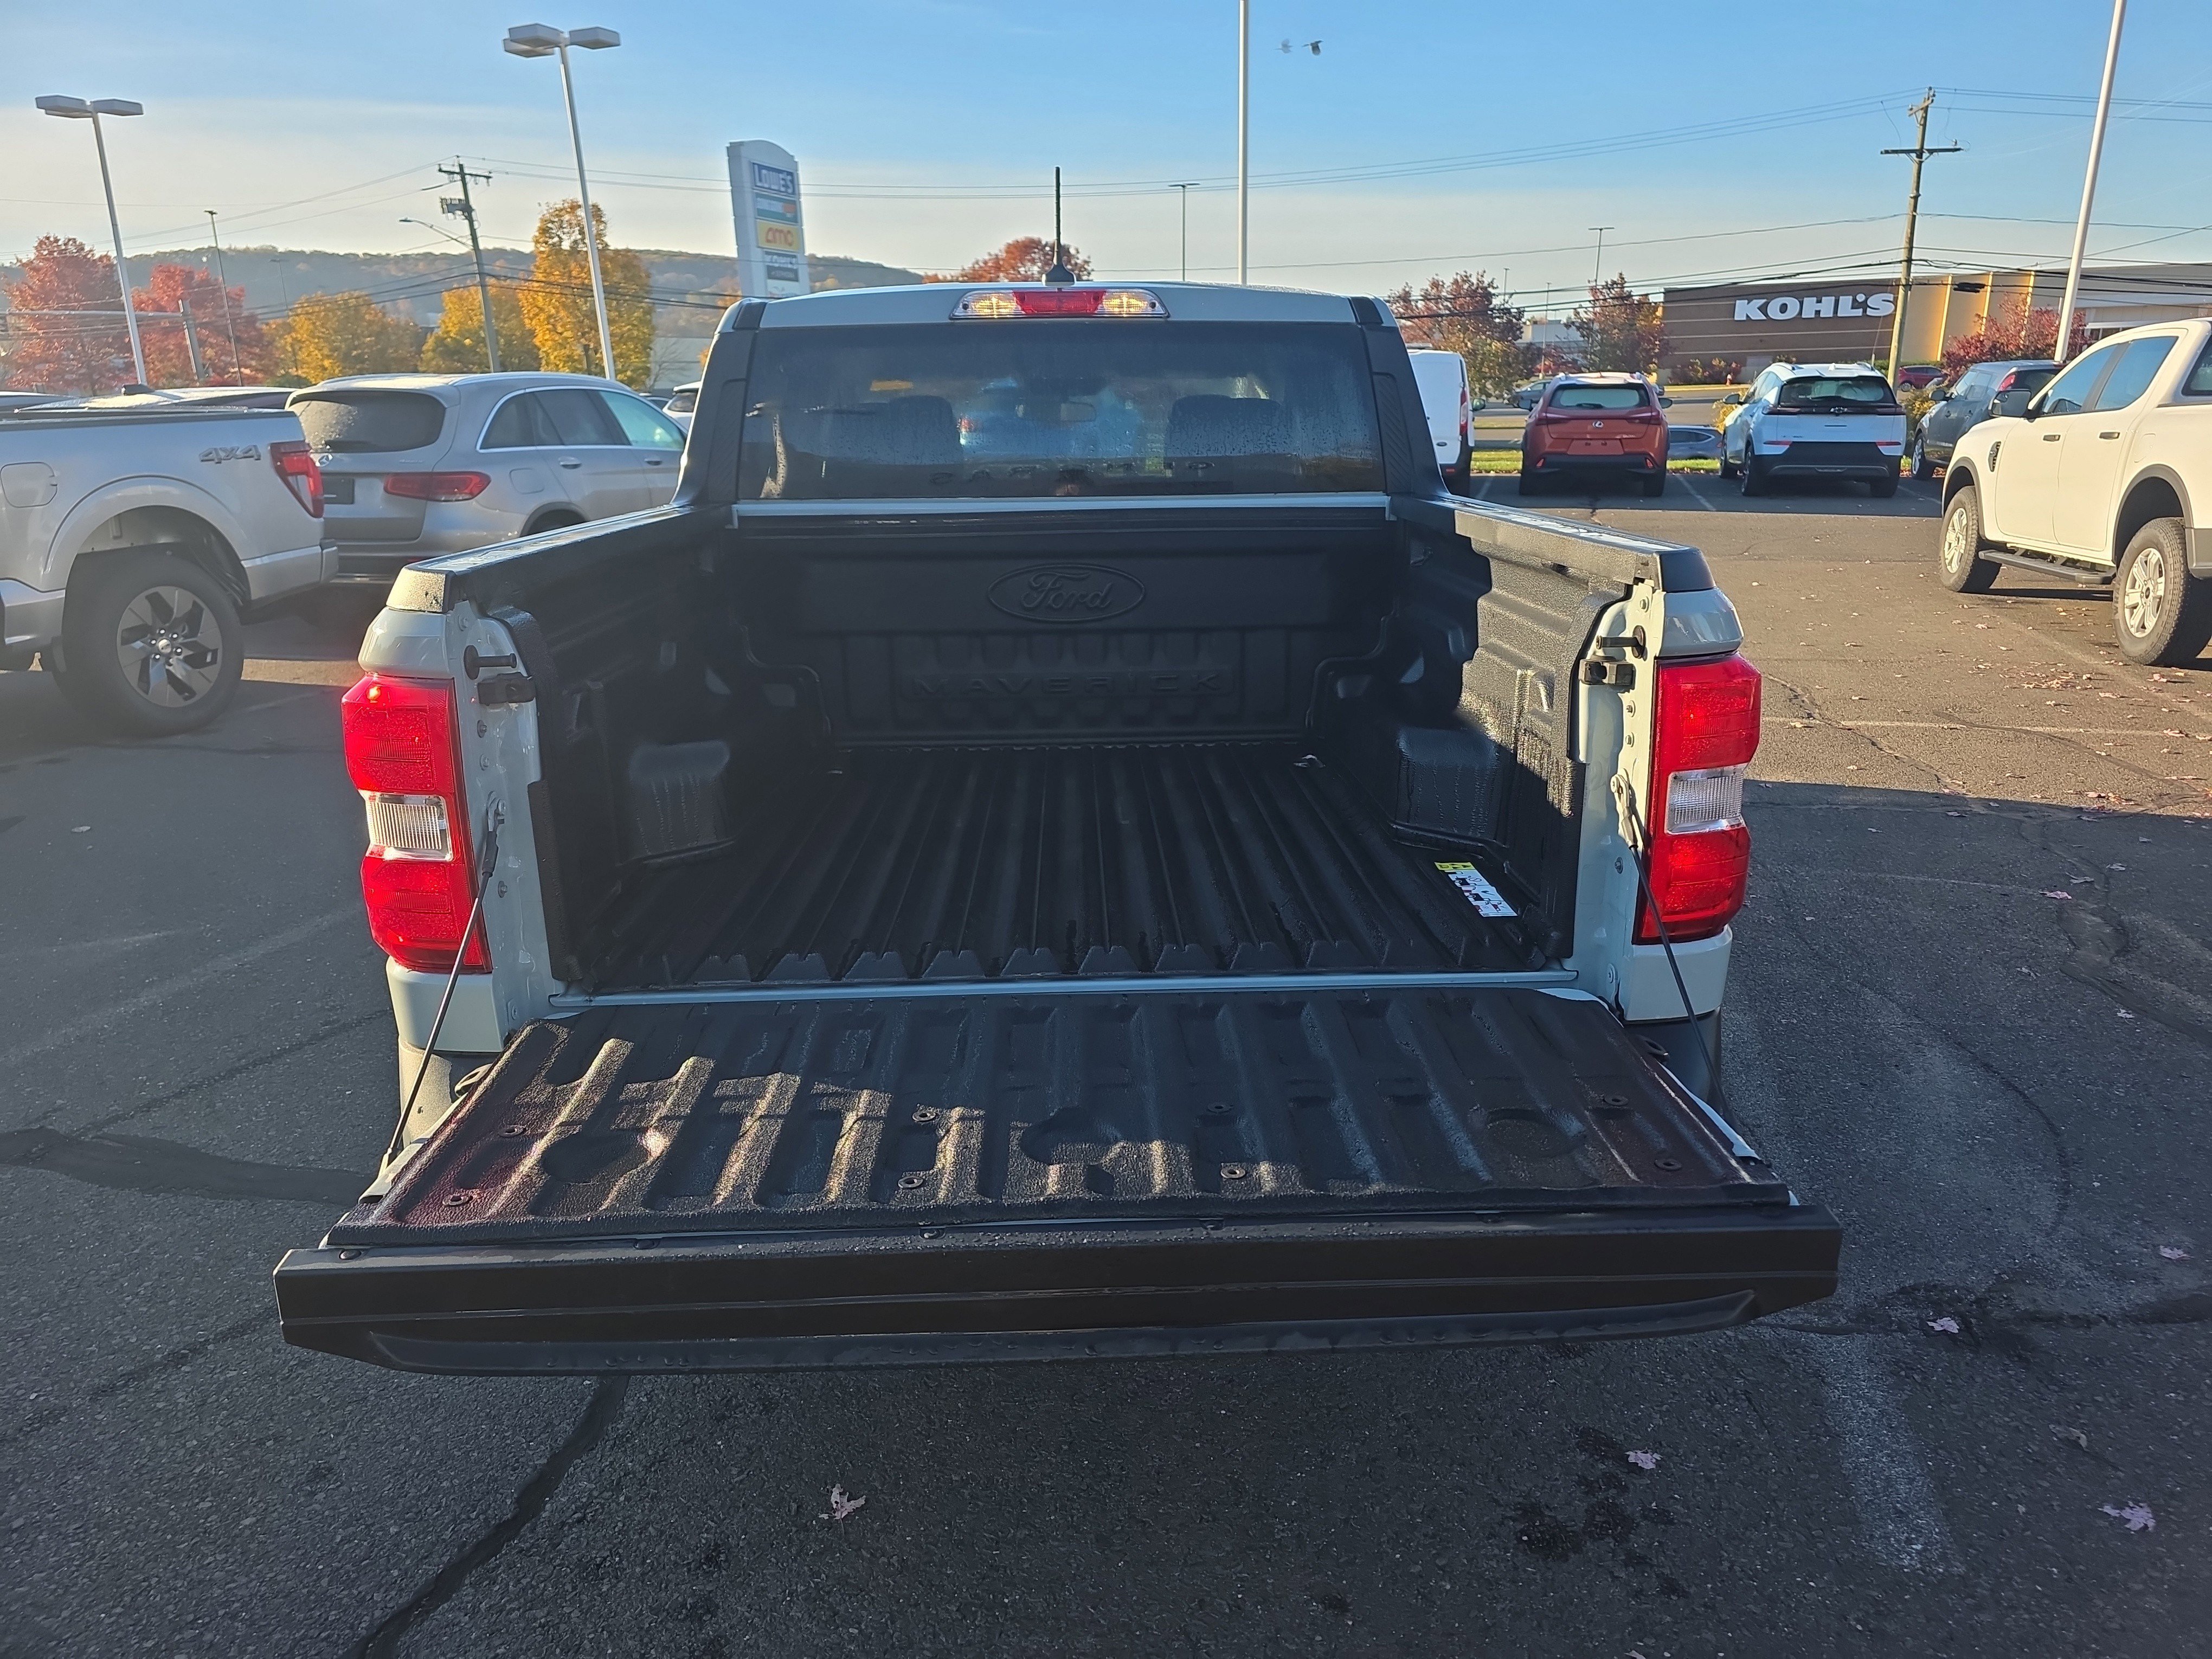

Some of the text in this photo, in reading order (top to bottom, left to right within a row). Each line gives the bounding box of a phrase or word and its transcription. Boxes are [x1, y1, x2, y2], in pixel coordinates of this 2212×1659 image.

[1734, 293, 1895, 320] KOHL'S
[1020, 571, 1114, 611] Ford
[913, 673, 1224, 695] MAVERICK
